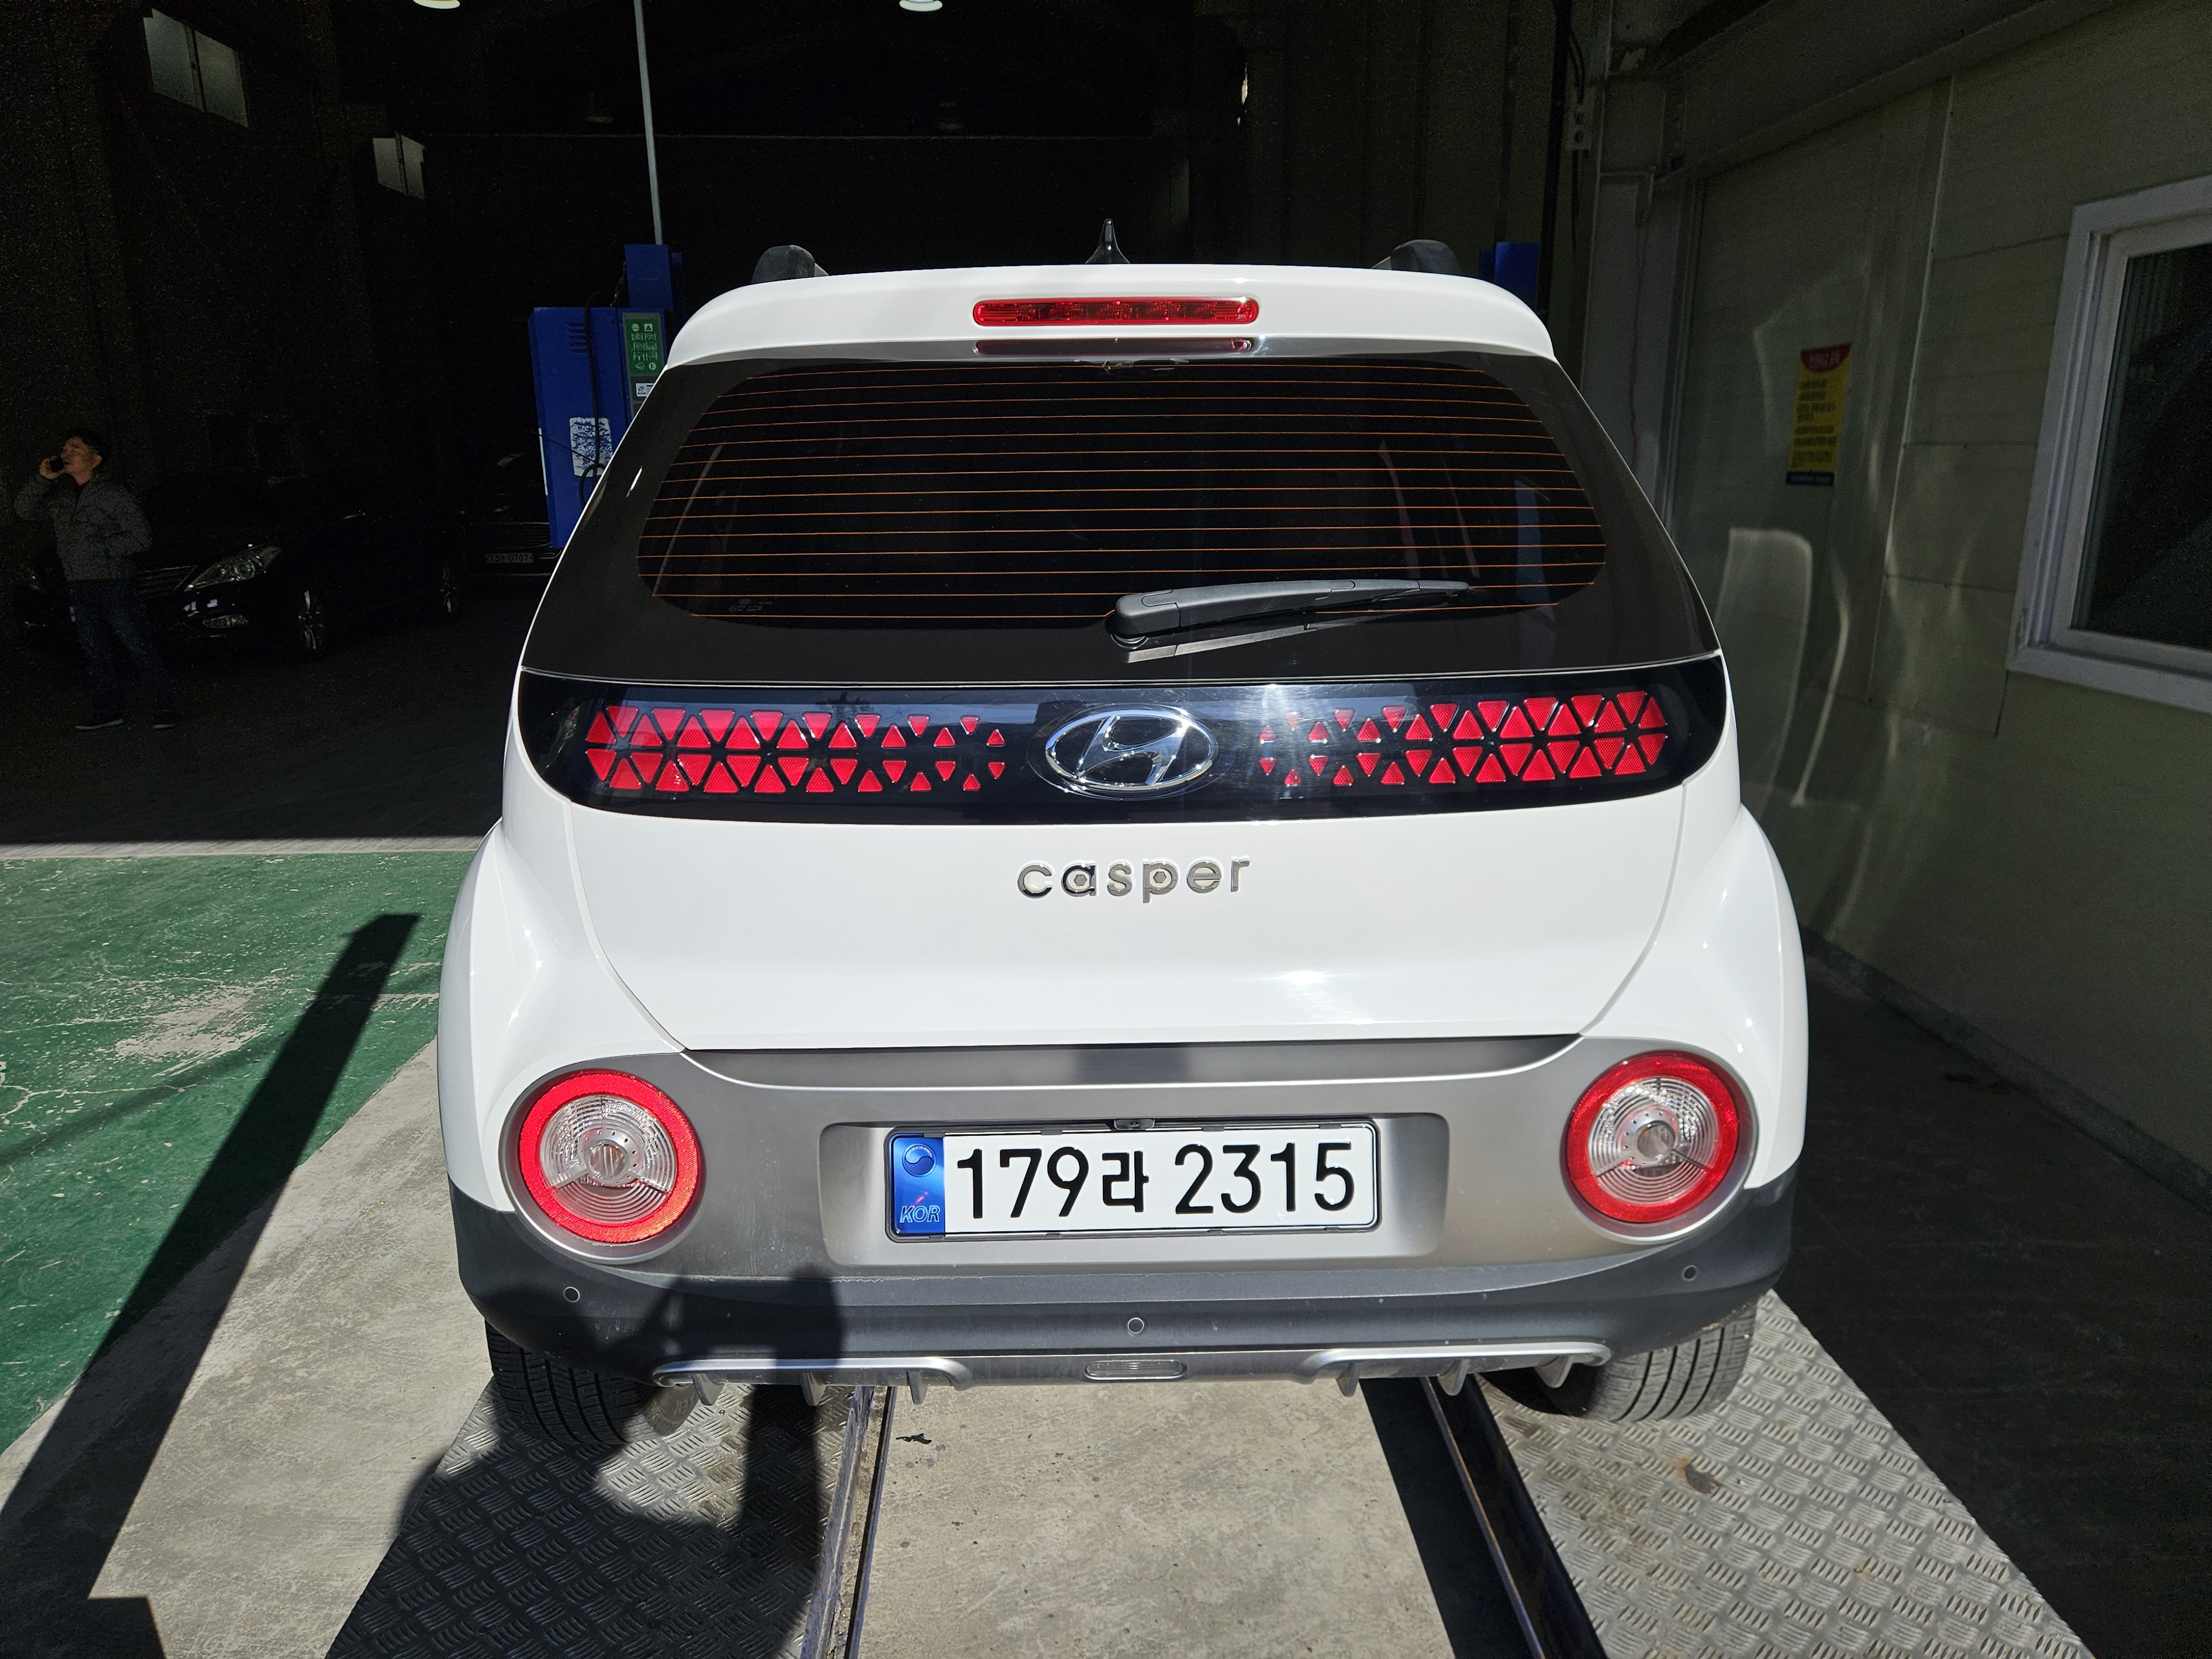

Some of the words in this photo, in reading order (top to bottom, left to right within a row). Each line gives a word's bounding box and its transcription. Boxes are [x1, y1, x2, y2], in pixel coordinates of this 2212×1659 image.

[1017, 857, 1251, 904] casper
[957, 1146, 1149, 1219] 179라
[1175, 1142, 1355, 1215] 2315
[899, 1205, 941, 1223] KOR
